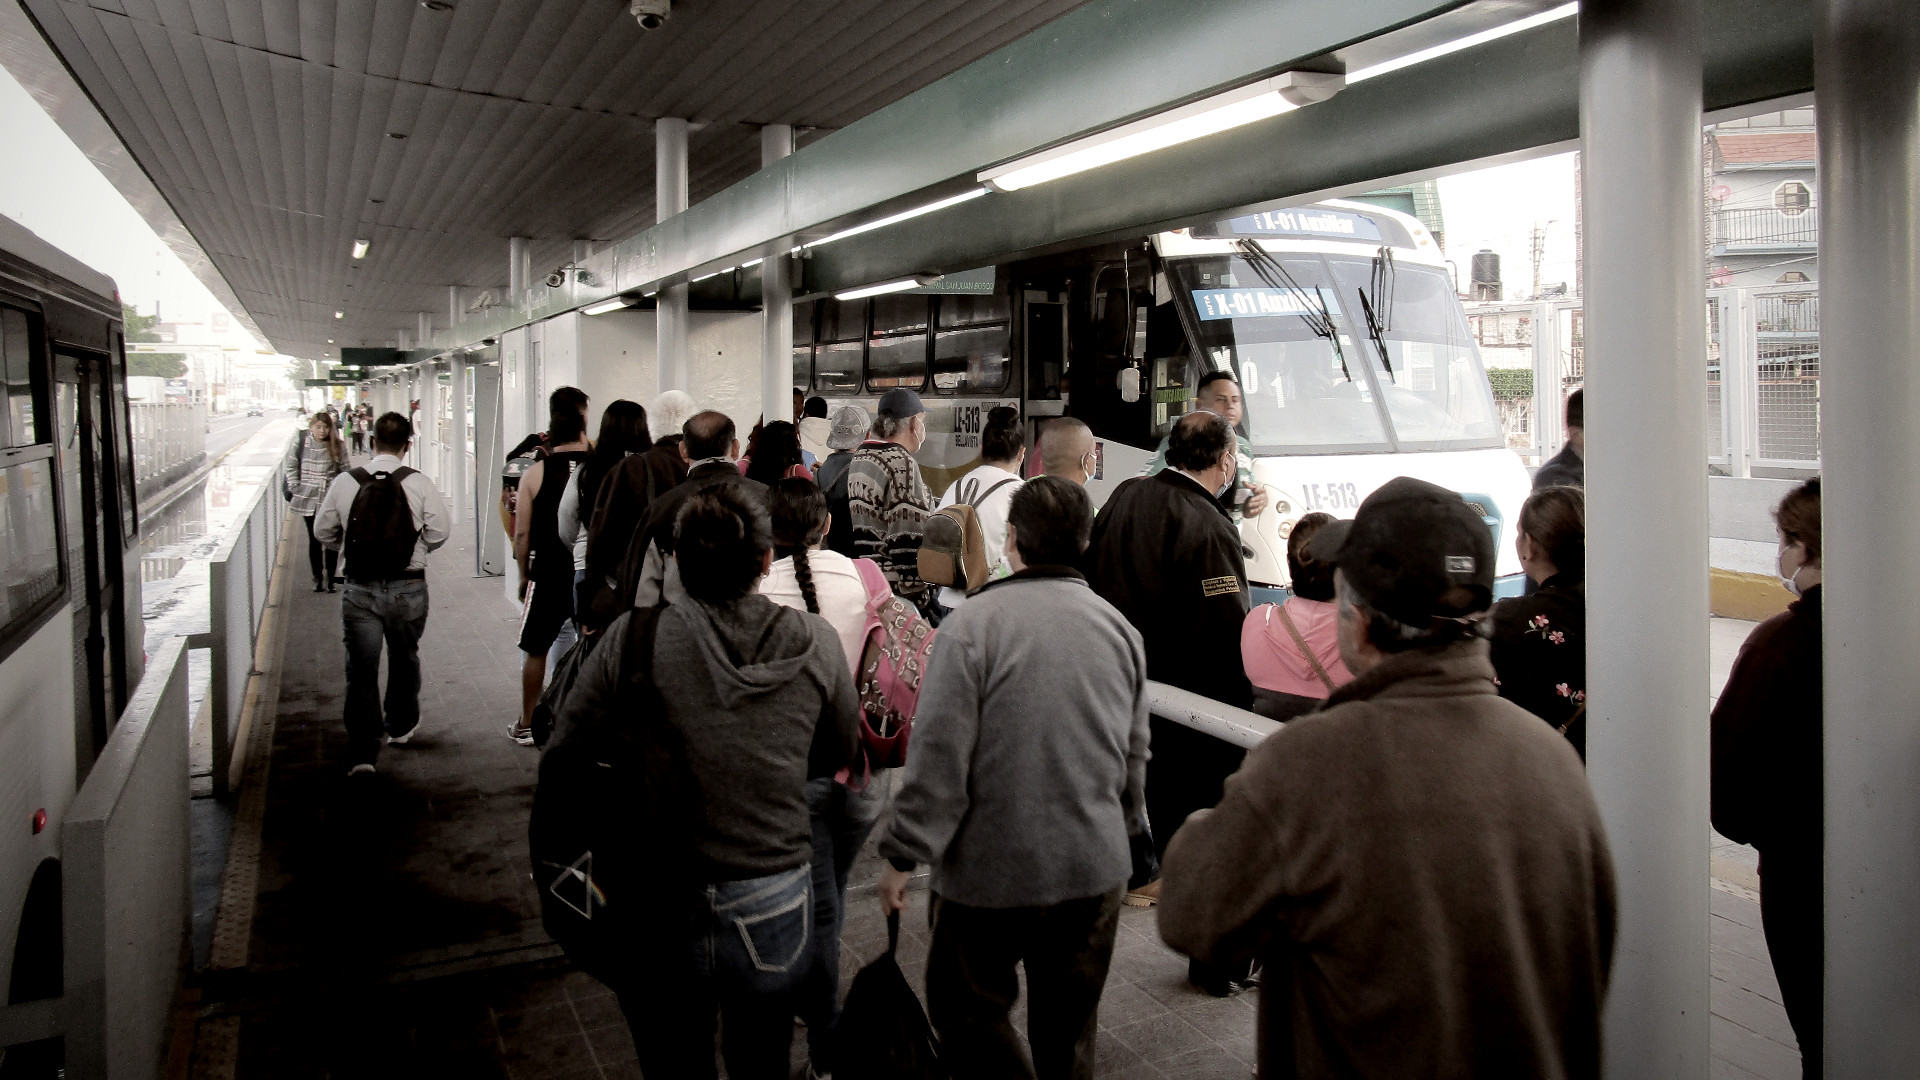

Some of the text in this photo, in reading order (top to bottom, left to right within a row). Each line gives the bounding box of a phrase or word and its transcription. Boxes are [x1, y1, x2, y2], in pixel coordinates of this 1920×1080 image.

[1262, 211, 1355, 234] X-01 Auxiliar
[1204, 295, 1215, 316] RUTA
[1214, 292, 1258, 316] X-01
[954, 406, 980, 433] LE-513
[1302, 482, 1360, 510] LE-513
